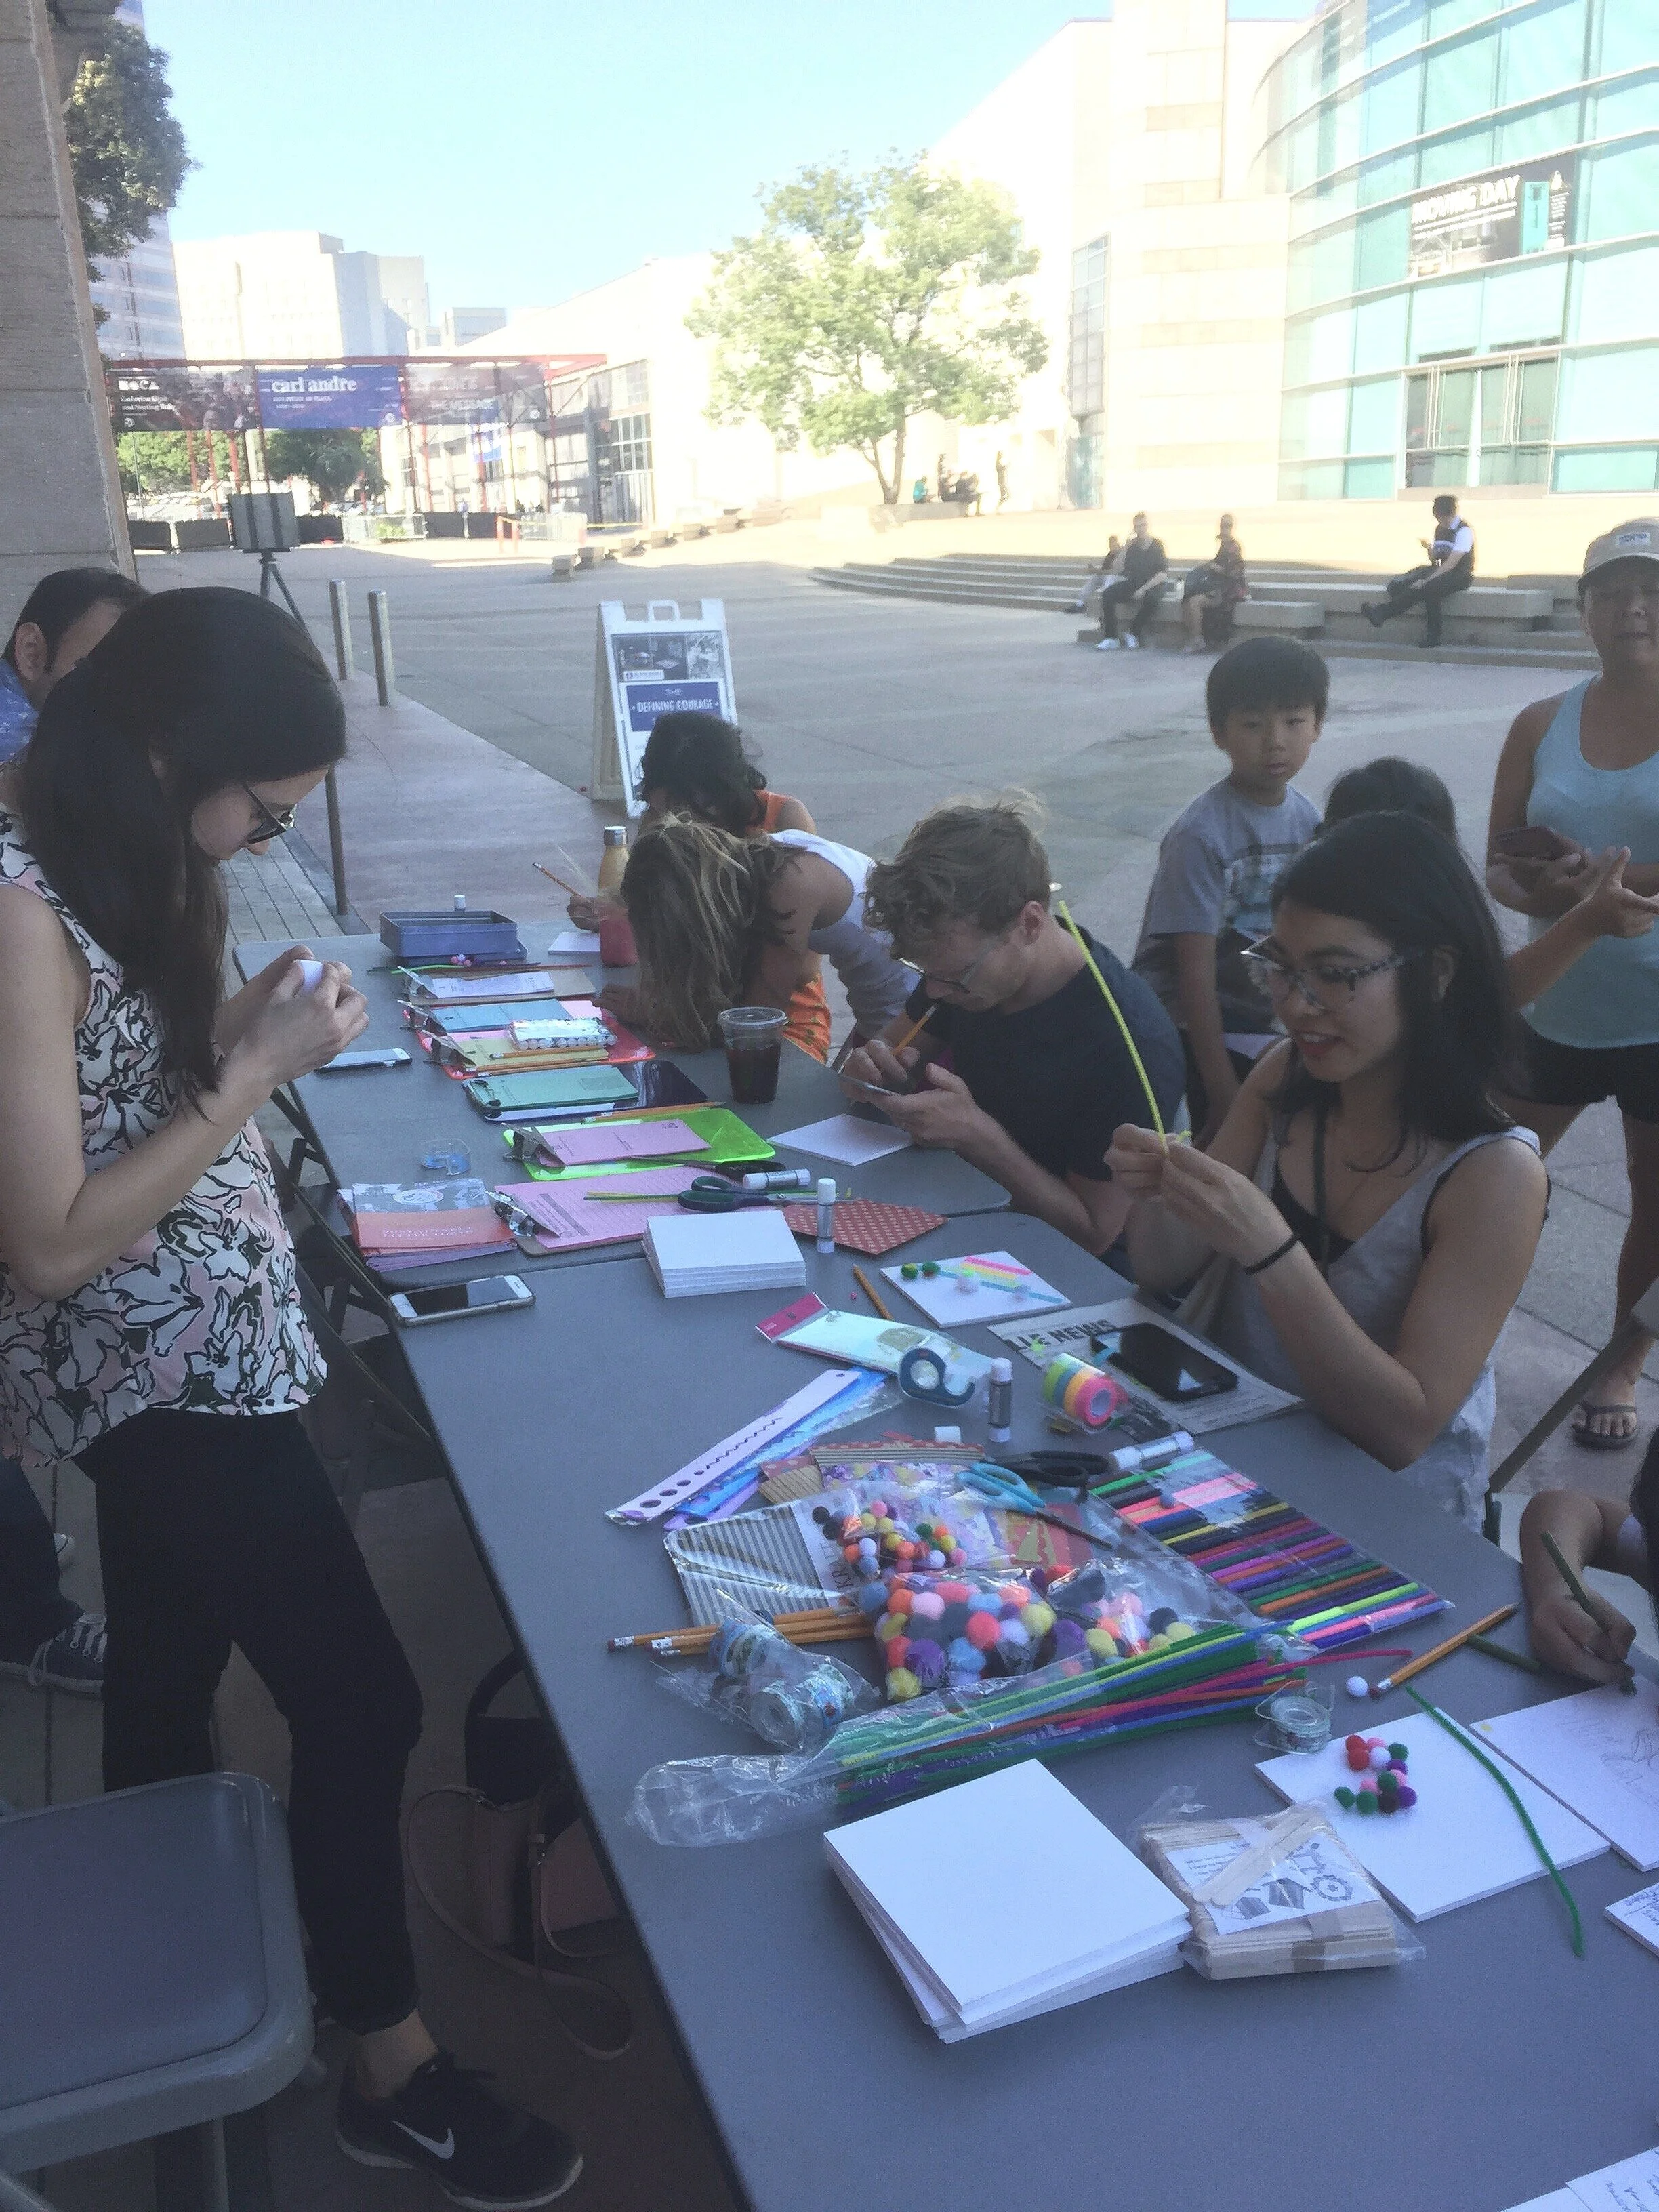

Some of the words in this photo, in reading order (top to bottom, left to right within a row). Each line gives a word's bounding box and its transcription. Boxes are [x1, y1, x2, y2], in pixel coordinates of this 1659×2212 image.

[1479, 173, 1521, 207] DAY
[271, 375, 305, 392] carl
[308, 375, 358, 392] andre
[665, 687, 683, 696] THE
[636, 699, 675, 713] DEFINING
[677, 698, 714, 711] COURAGE
